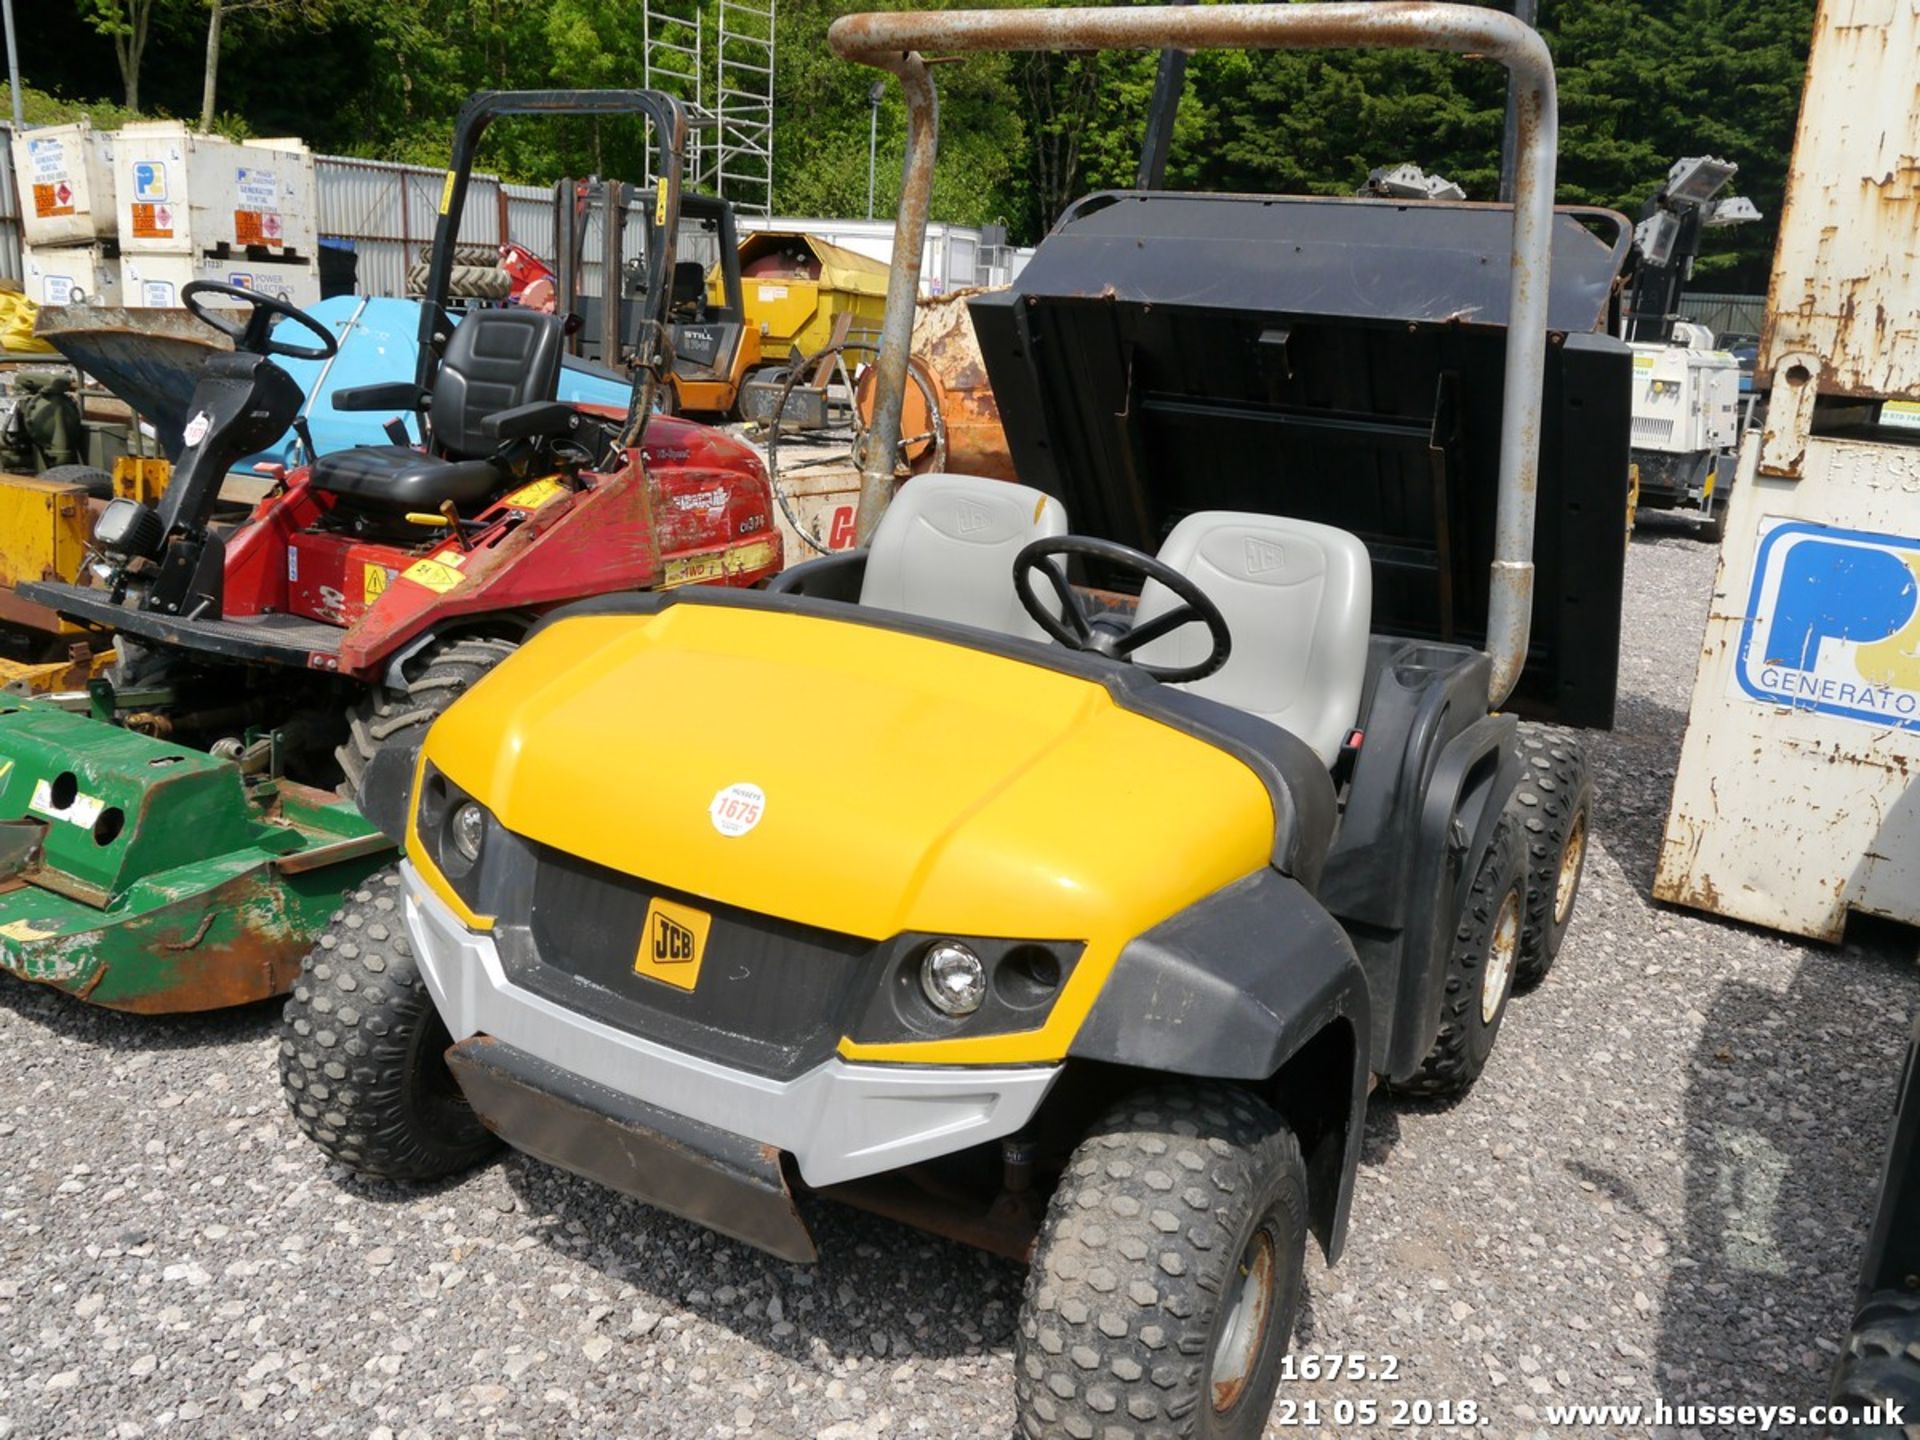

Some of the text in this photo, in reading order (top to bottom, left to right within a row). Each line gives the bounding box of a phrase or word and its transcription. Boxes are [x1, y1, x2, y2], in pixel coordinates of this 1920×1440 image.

[684, 327, 714, 341] STILL
[717, 797, 760, 824] 1675
[655, 918, 692, 959] JCB
